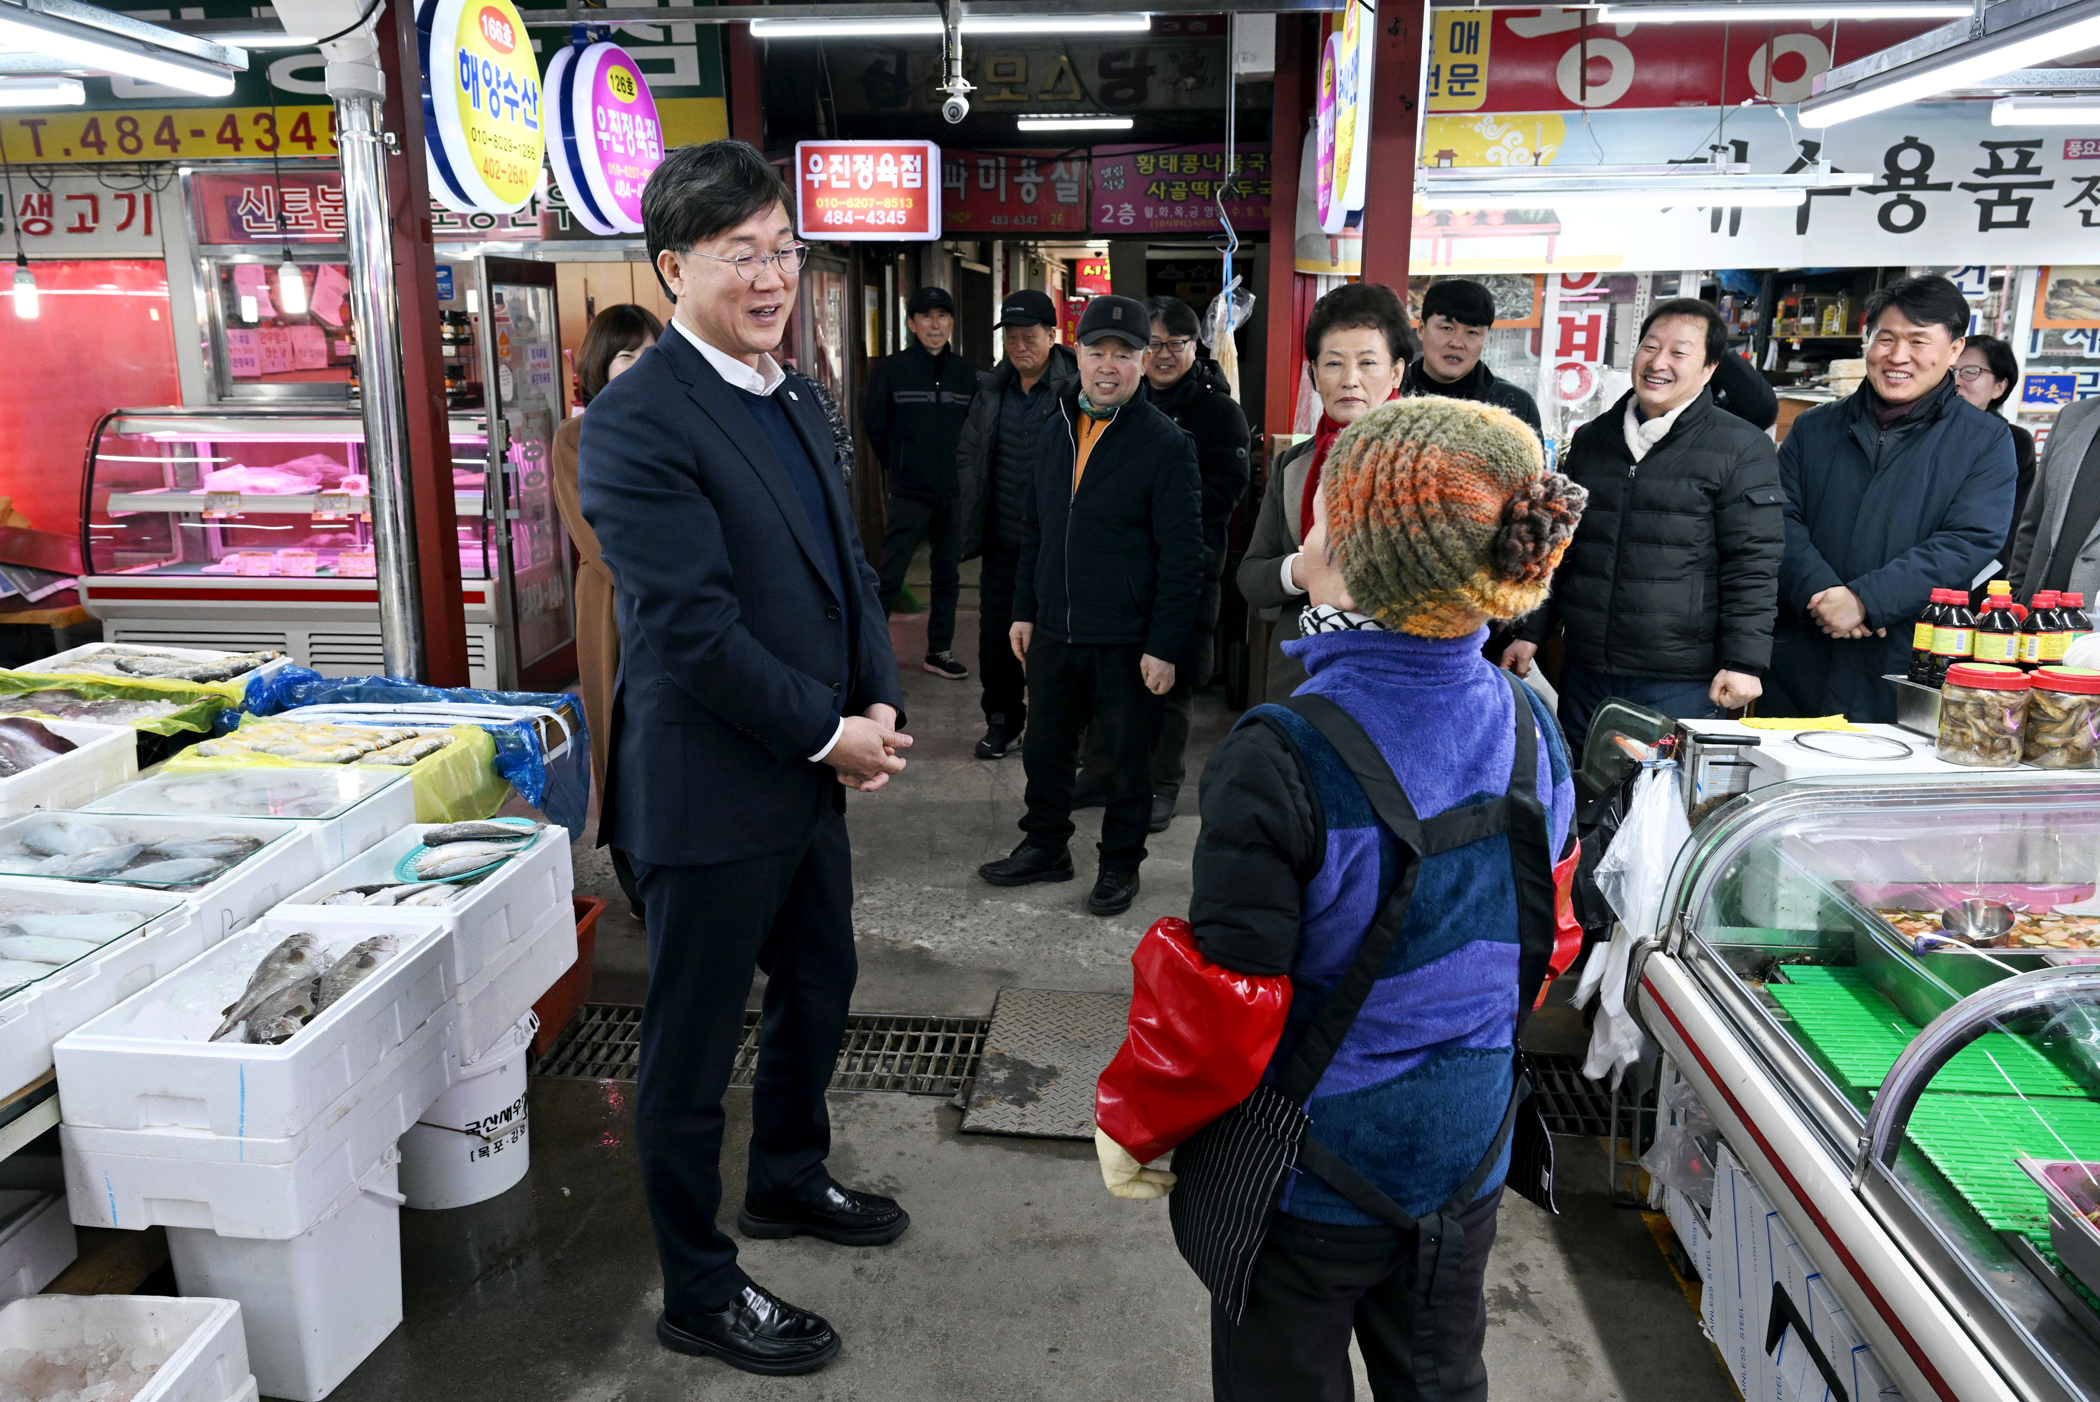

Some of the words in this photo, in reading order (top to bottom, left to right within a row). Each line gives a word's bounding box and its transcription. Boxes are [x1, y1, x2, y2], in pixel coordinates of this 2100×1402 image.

[482, 14, 513, 48] 166호
[458, 48, 538, 131] 해양수산
[610, 74, 635, 96] 126호
[471, 127, 536, 160] 010-8029-1286
[597, 105, 660, 161] 우진정육점
[2067, 140, 2100, 157] 풍요
[483, 157, 529, 187] 402-2641
[806, 153, 922, 190] 우진정육점
[1135, 153, 1271, 175] 황태콩나물국
[1102, 179, 1126, 191] 식당
[816, 198, 914, 209] 010-6207-8513
[1101, 203, 1136, 226] 2층
[823, 210, 907, 225] 484-4345
[947, 212, 972, 223] SHOP
[990, 215, 1038, 226] 483-6342
